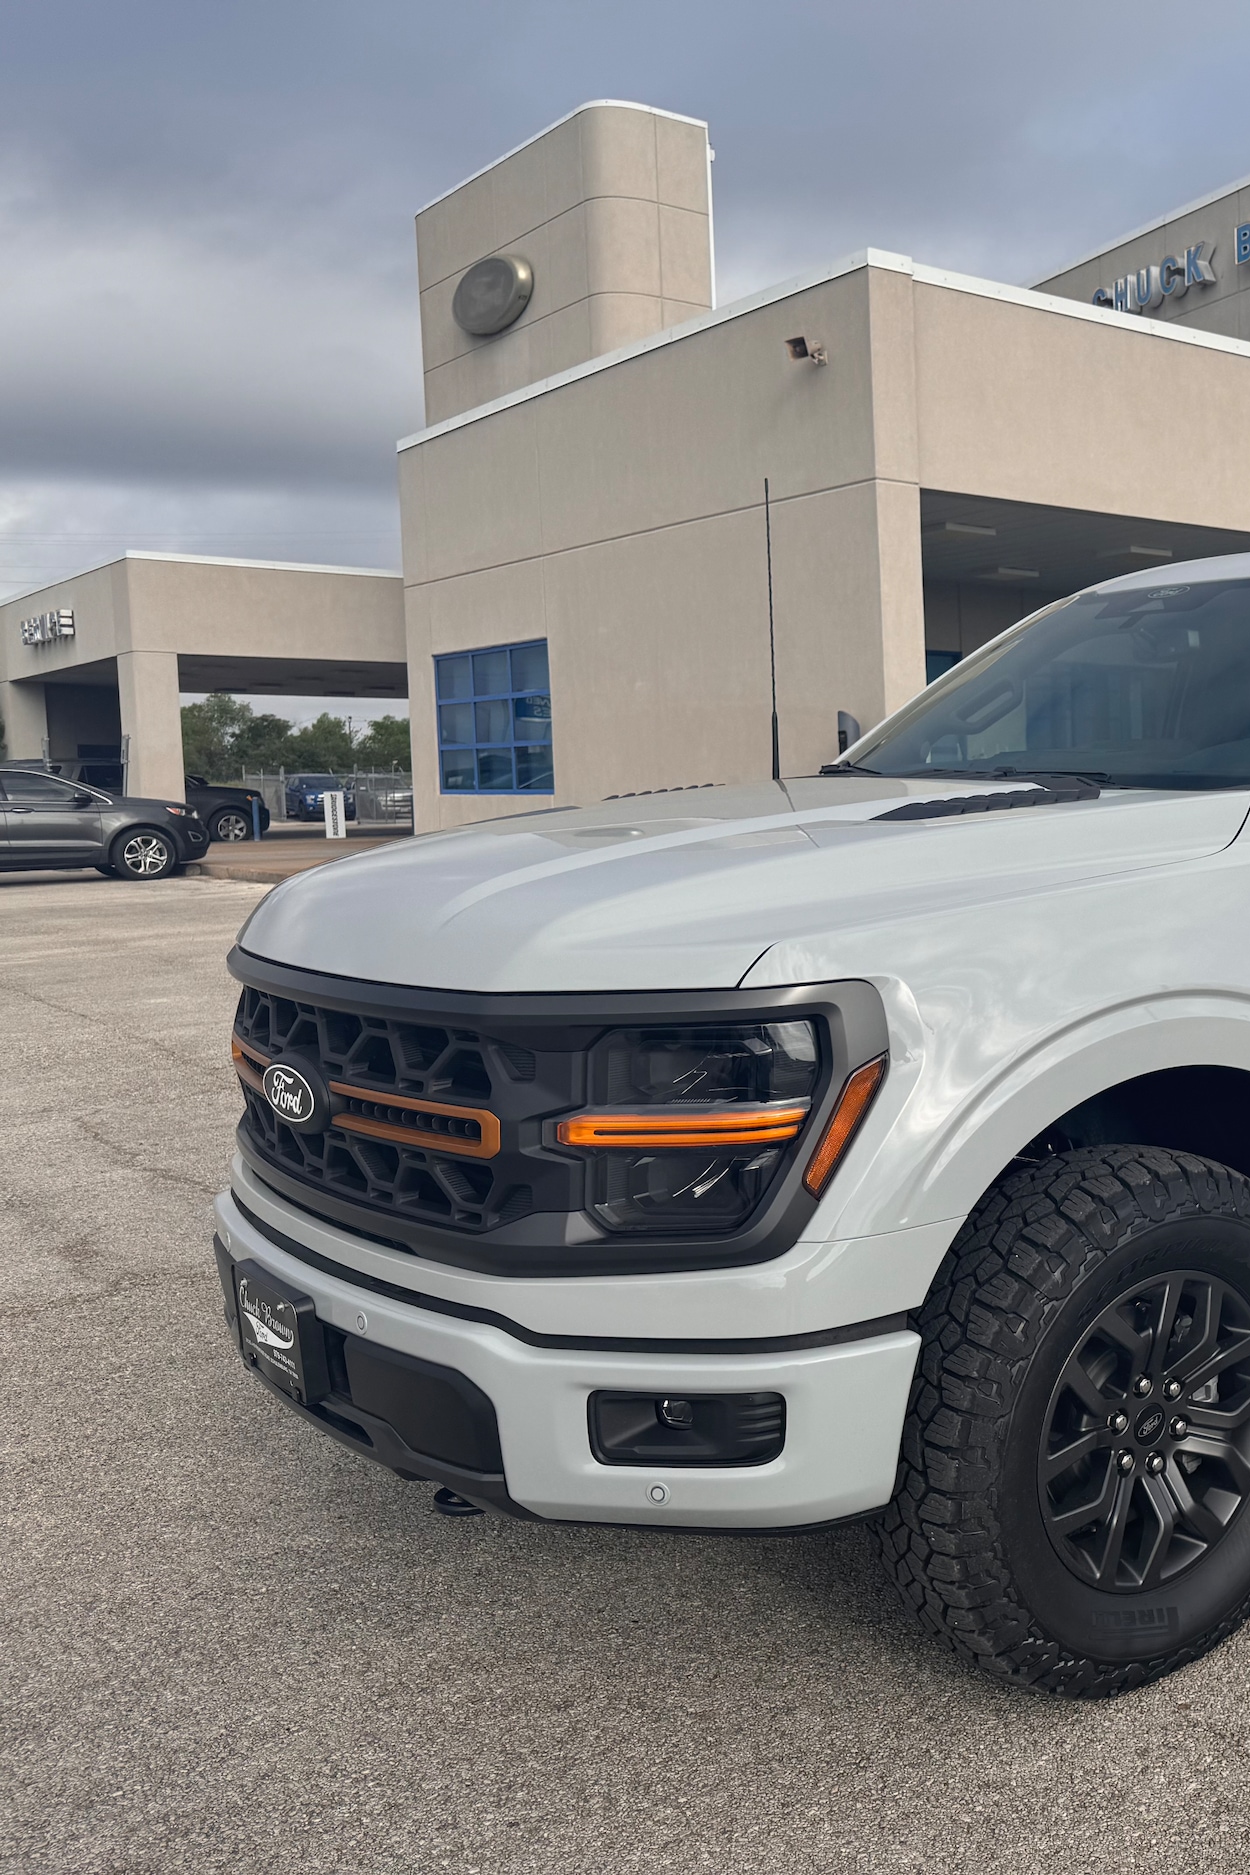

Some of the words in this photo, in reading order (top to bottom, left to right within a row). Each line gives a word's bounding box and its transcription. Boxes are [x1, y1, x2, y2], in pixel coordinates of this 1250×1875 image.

[271, 1070, 303, 1115] Ford
[239, 1286, 261, 1318] Chuck
[261, 1302, 294, 1340] Brown
